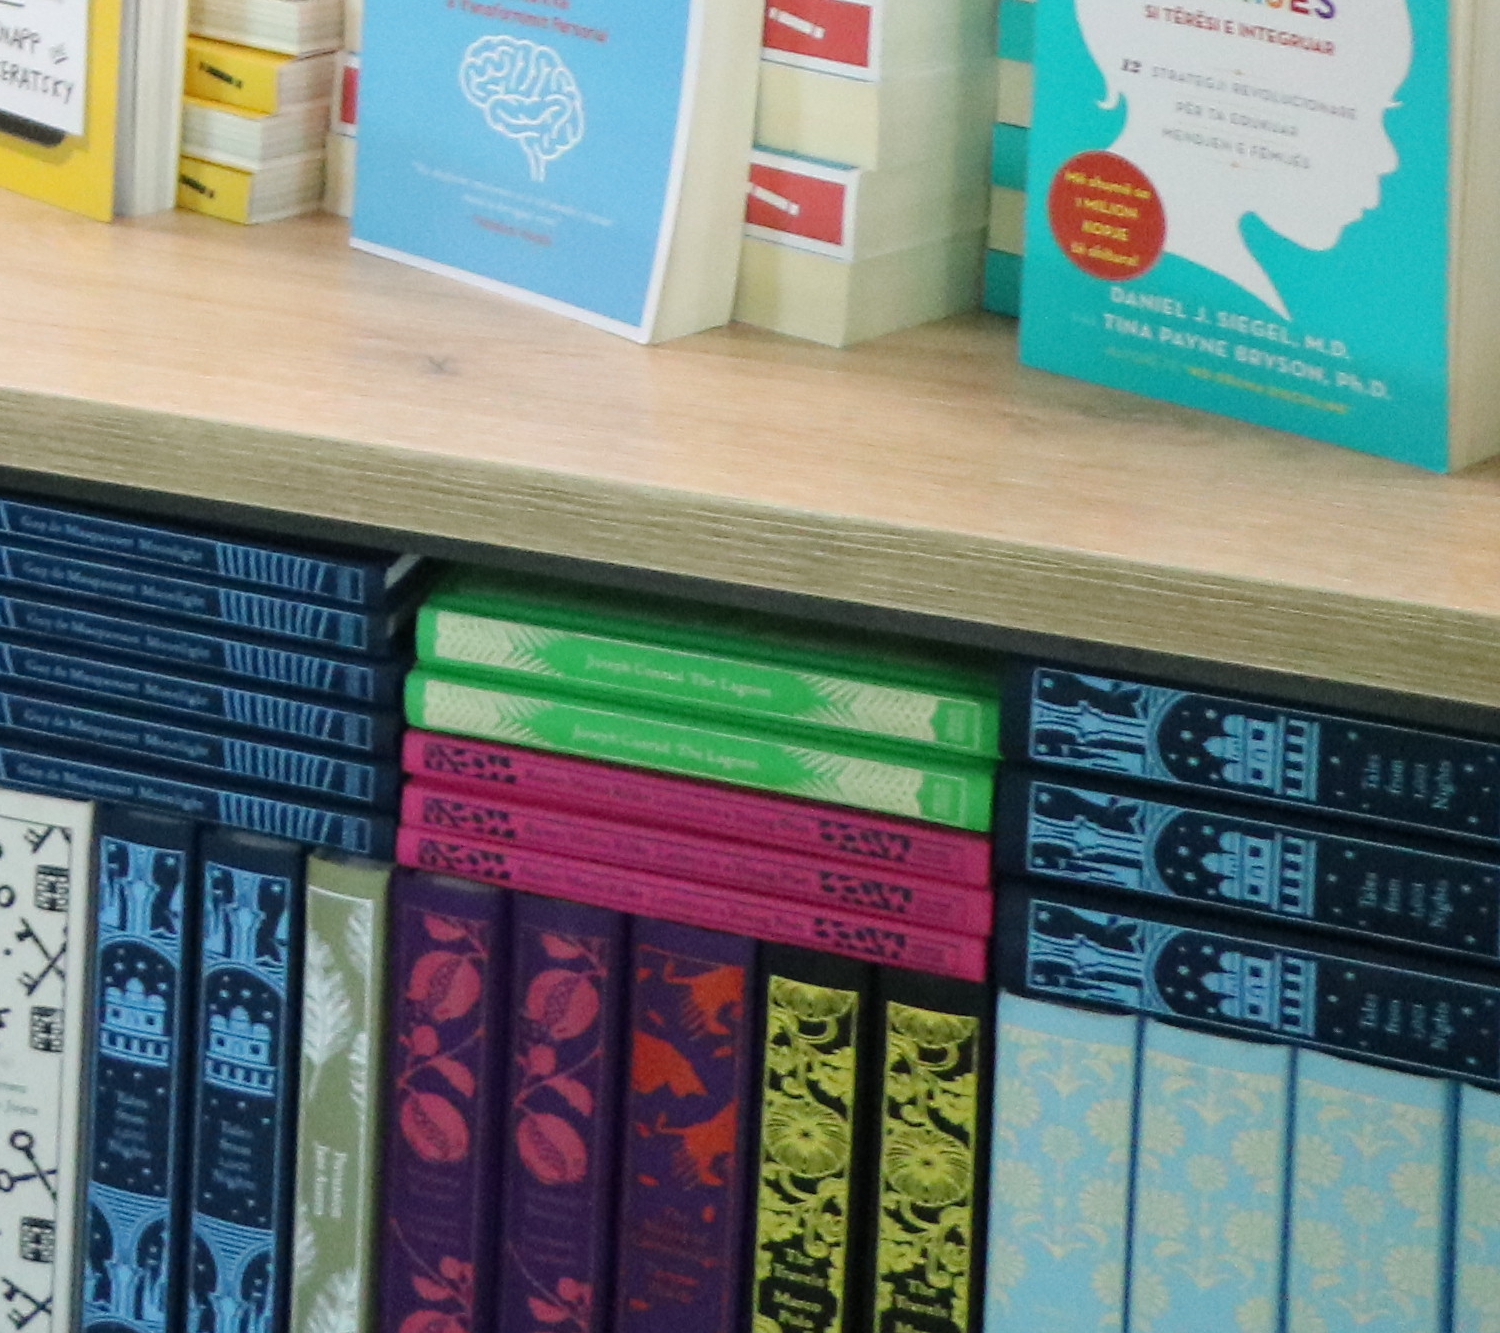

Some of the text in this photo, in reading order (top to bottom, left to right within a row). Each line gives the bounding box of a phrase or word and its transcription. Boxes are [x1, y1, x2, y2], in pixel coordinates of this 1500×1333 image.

[1237, 22, 1336, 57] INTEGRUAR
[1109, 285, 1188, 319] DANIEL
[1103, 312, 1152, 339] TINA
[1158, 324, 1229, 359] PAYNE
